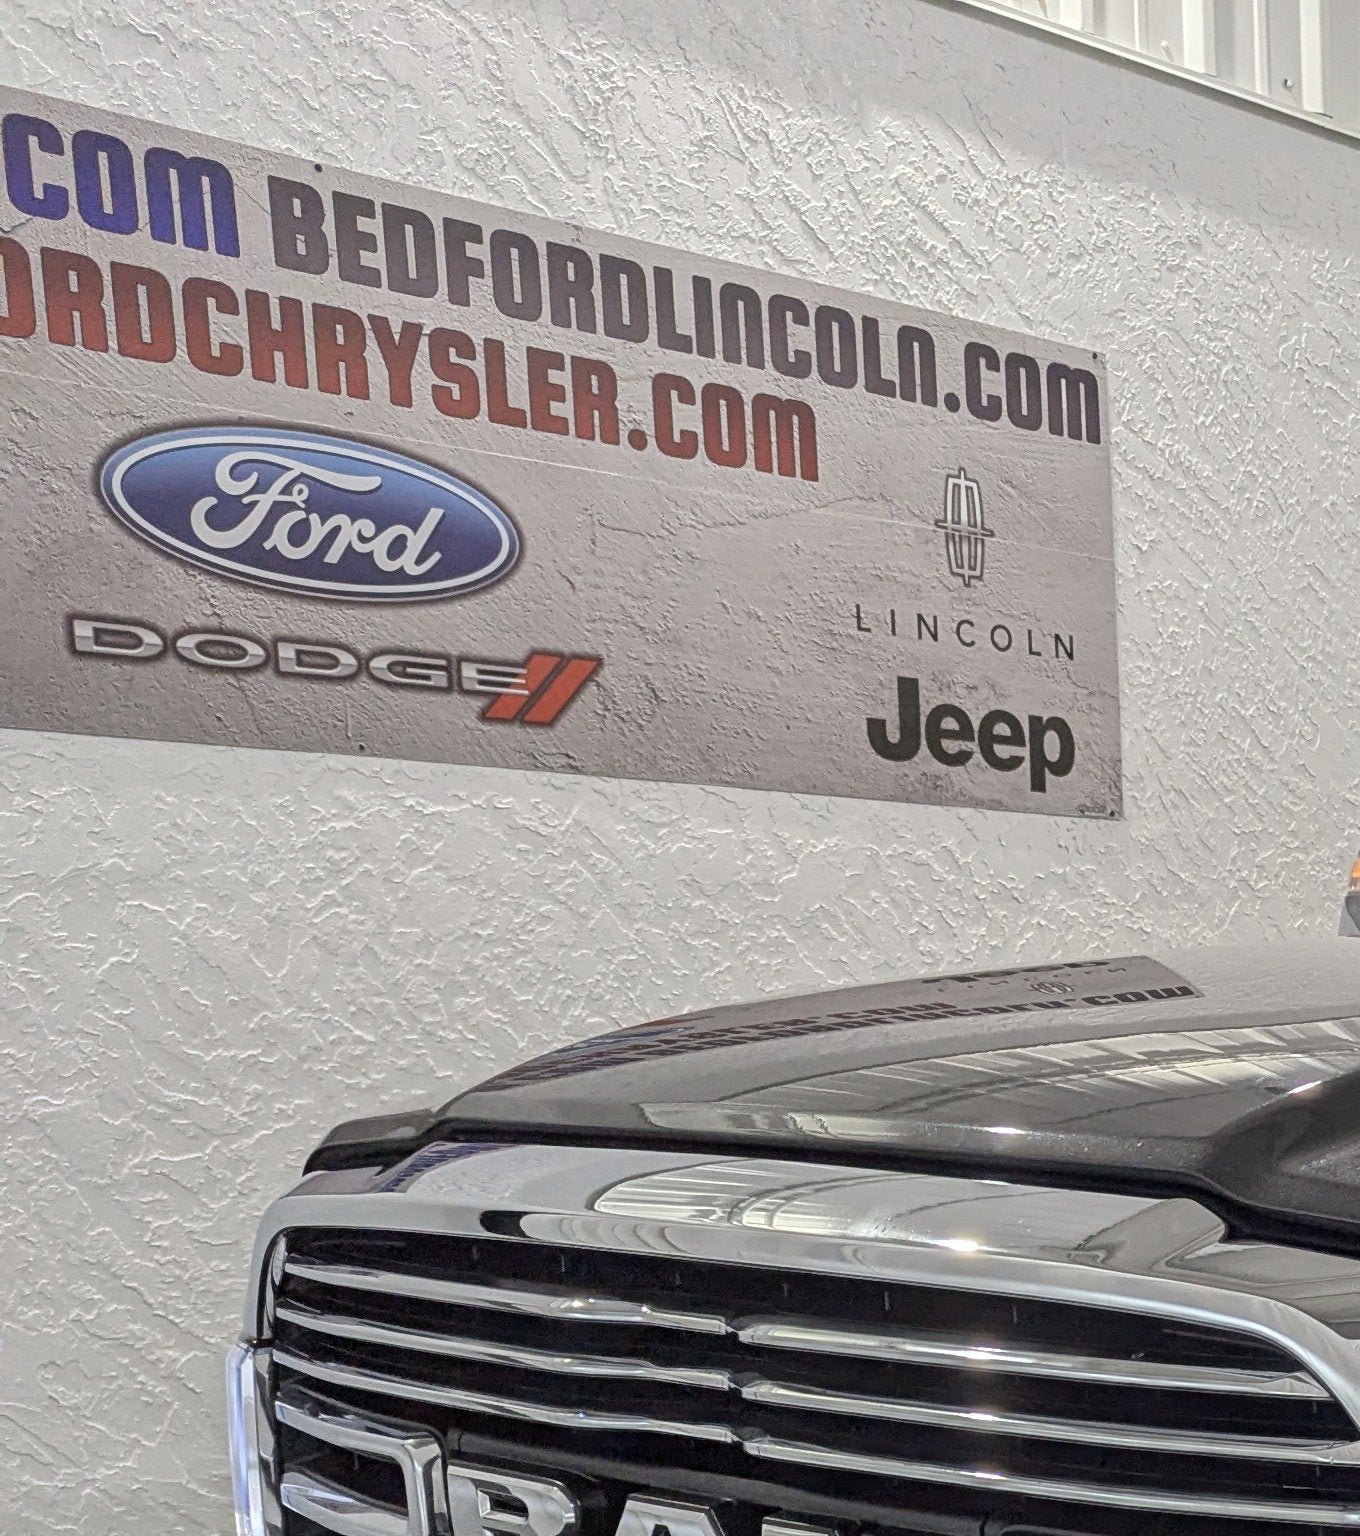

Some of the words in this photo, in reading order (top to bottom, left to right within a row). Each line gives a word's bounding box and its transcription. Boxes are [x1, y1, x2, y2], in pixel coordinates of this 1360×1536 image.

[2, 113, 241, 258] COM
[268, 175, 1102, 445] BEDFORDLINCOLN.COM
[190, 451, 444, 577] Ford
[73, 618, 530, 697] DODGE
[855, 604, 1075, 661] LINCOLN
[866, 675, 1076, 794] Jeep
